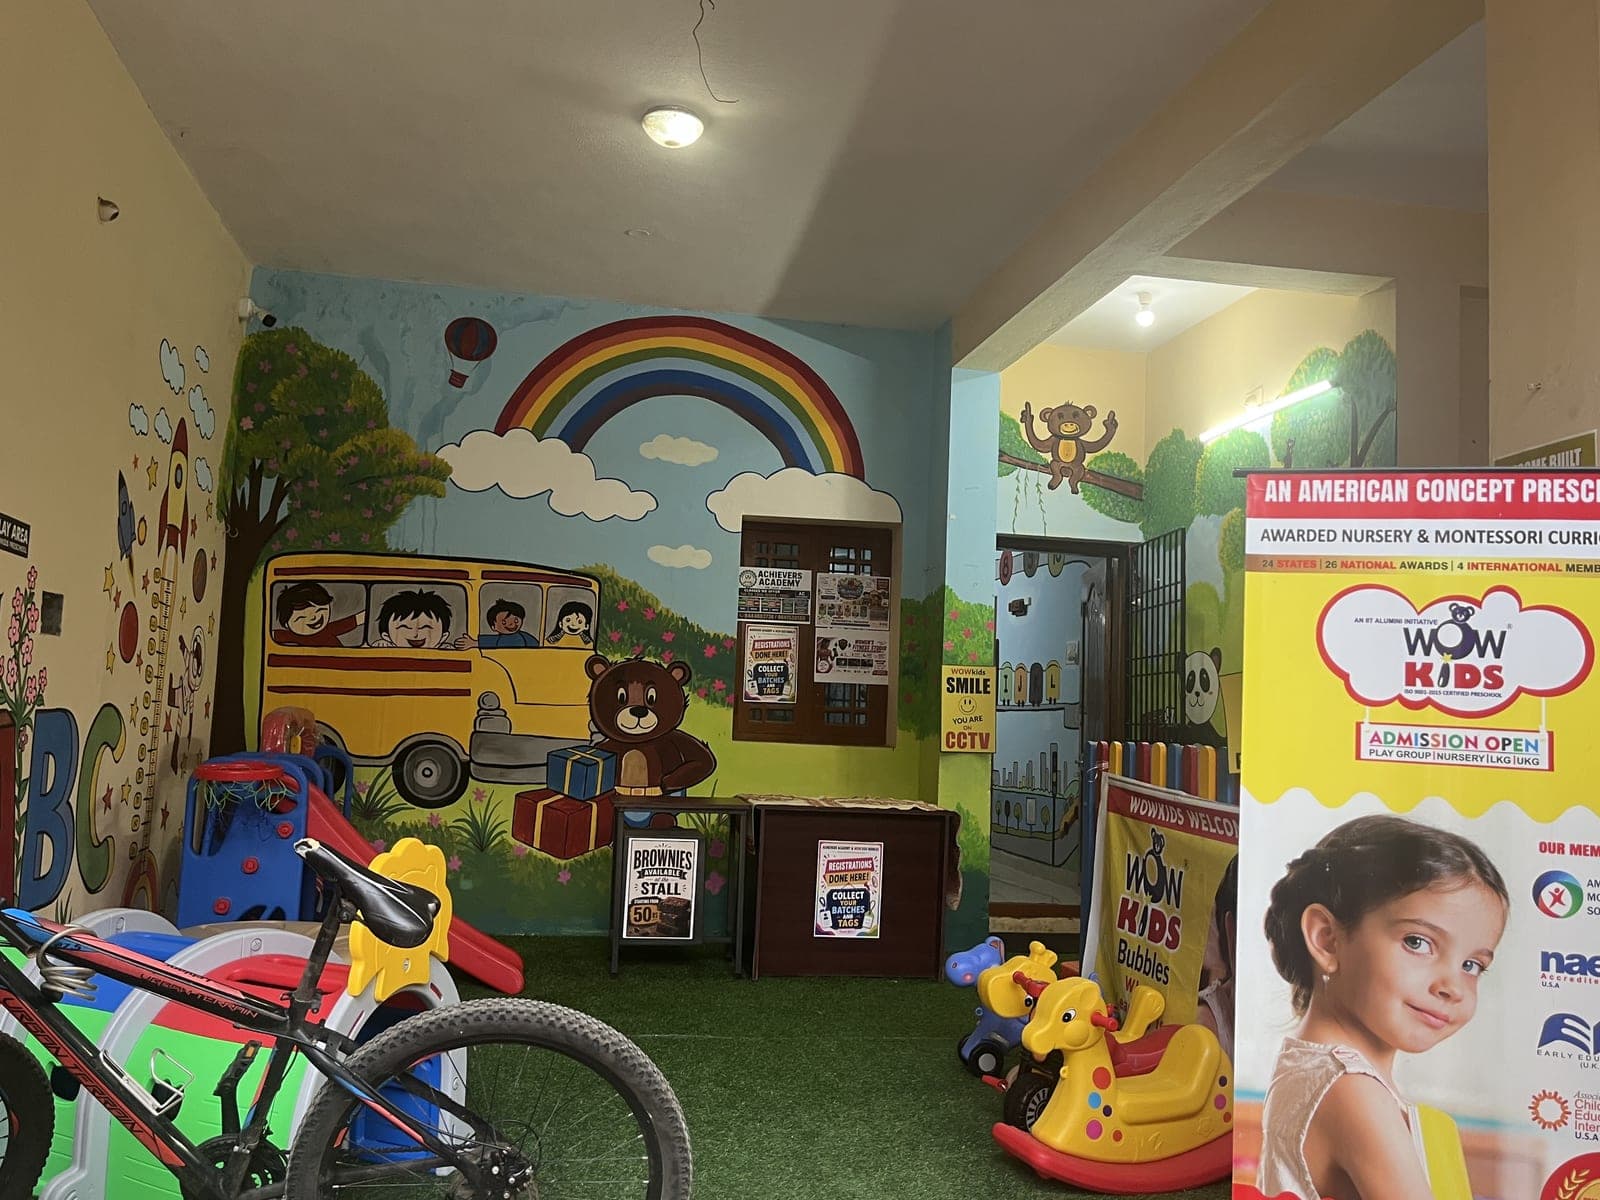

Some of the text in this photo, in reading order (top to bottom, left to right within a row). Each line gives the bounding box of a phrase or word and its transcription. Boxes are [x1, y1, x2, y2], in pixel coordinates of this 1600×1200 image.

[1265, 480, 1291, 502] AN
[1299, 479, 1408, 502] AMERICAN
[1416, 479, 1515, 502] CONCEPT
[11, 525, 28, 544] AREA
[1260, 529, 1337, 542] AWARDED
[1342, 529, 1412, 543] NURSERY
[1417, 529, 1429, 543] &
[1435, 529, 1542, 544] MONTESSORI
[1262, 560, 1274, 568] 24
[1276, 560, 1317, 568] STATES
[1325, 560, 1337, 568] 26
[1341, 560, 1396, 569] NATIONAL
[1399, 561, 1448, 570] AWARDS
[1457, 562, 1464, 570] 4
[1467, 562, 1562, 572] INTERNATIONAL
[758, 570, 803, 579] ACHIEVERS
[759, 579, 801, 587] ACADEMY
[1403, 620, 1507, 660] WOW
[755, 651, 771, 659] DONE
[758, 665, 785, 673] COLLECT
[1404, 661, 1505, 690] KIDS
[946, 677, 991, 695] SMILE
[953, 717, 968, 725] YOU
[945, 731, 990, 750] CCTV
[1369, 731, 1539, 753] ADMISSION OPEN
[1369, 749, 1540, 766] PLAY GROUP NURSERY LKG UKG
[1130, 796, 1184, 825] WOWKIDS
[1539, 841, 1565, 855] OUR
[634, 849, 692, 870] BROWNIES
[828, 860, 872, 871] REGISTRATIONS
[644, 868, 680, 877] AVAILABLE
[829, 873, 869, 884] DONE HERE!
[1126, 850, 1183, 909] WOW
[641, 882, 681, 895] STALL
[832, 891, 864, 900] COLLECT
[633, 906, 651, 922] 50
[832, 905, 865, 914] BATCHES
[838, 919, 859, 928] TAGS
[1117, 897, 1182, 950] KIDS
[1118, 939, 1169, 985] Bubbles
[1537, 1049, 1573, 1059] EARLY
